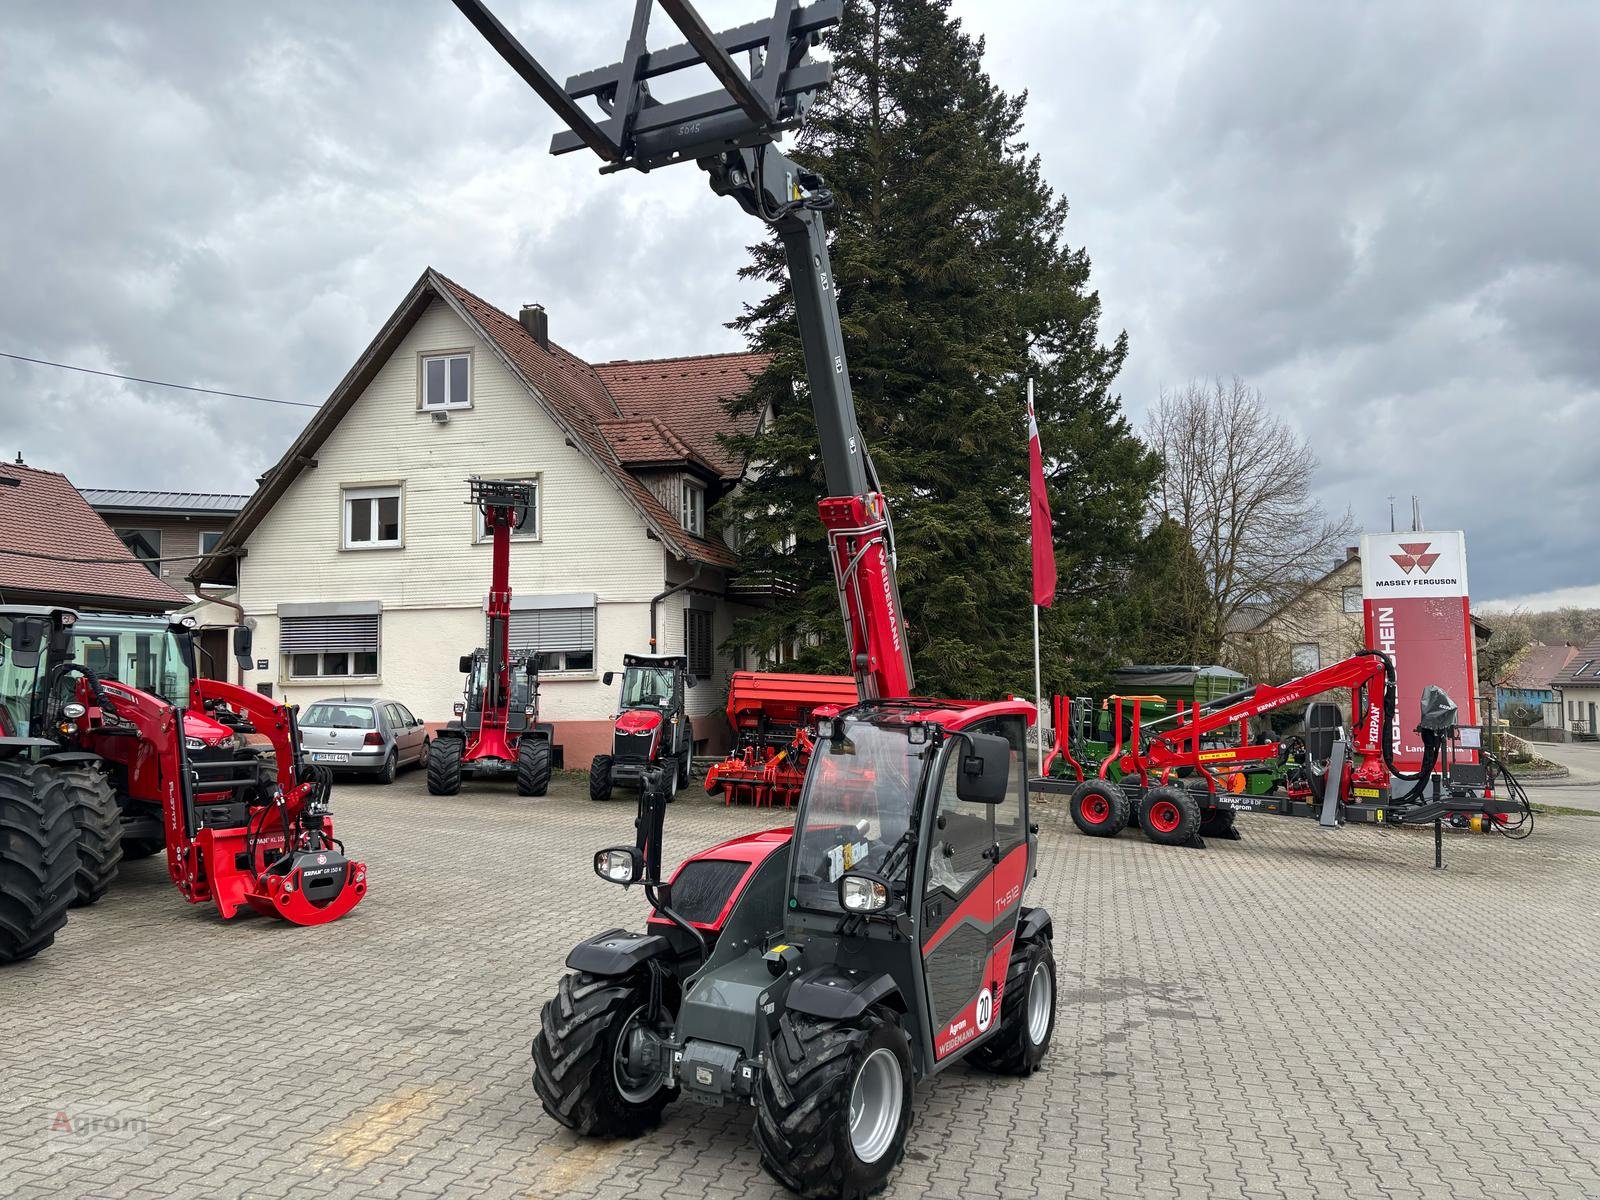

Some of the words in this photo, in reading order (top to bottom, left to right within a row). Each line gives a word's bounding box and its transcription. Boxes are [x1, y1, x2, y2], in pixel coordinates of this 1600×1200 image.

[1376, 579, 1411, 587] MASSEY
[1413, 578, 1457, 586] FERGUSON
[879, 548, 900, 652] WEIDEMANN
[1229, 711, 1249, 722] Agrom
[1370, 705, 1380, 742] KRPAN
[995, 885, 1019, 911] T4512
[980, 996, 989, 1024] 20
[939, 1026, 975, 1055] WEIDEMANN
[949, 1019, 967, 1036] Agrom
